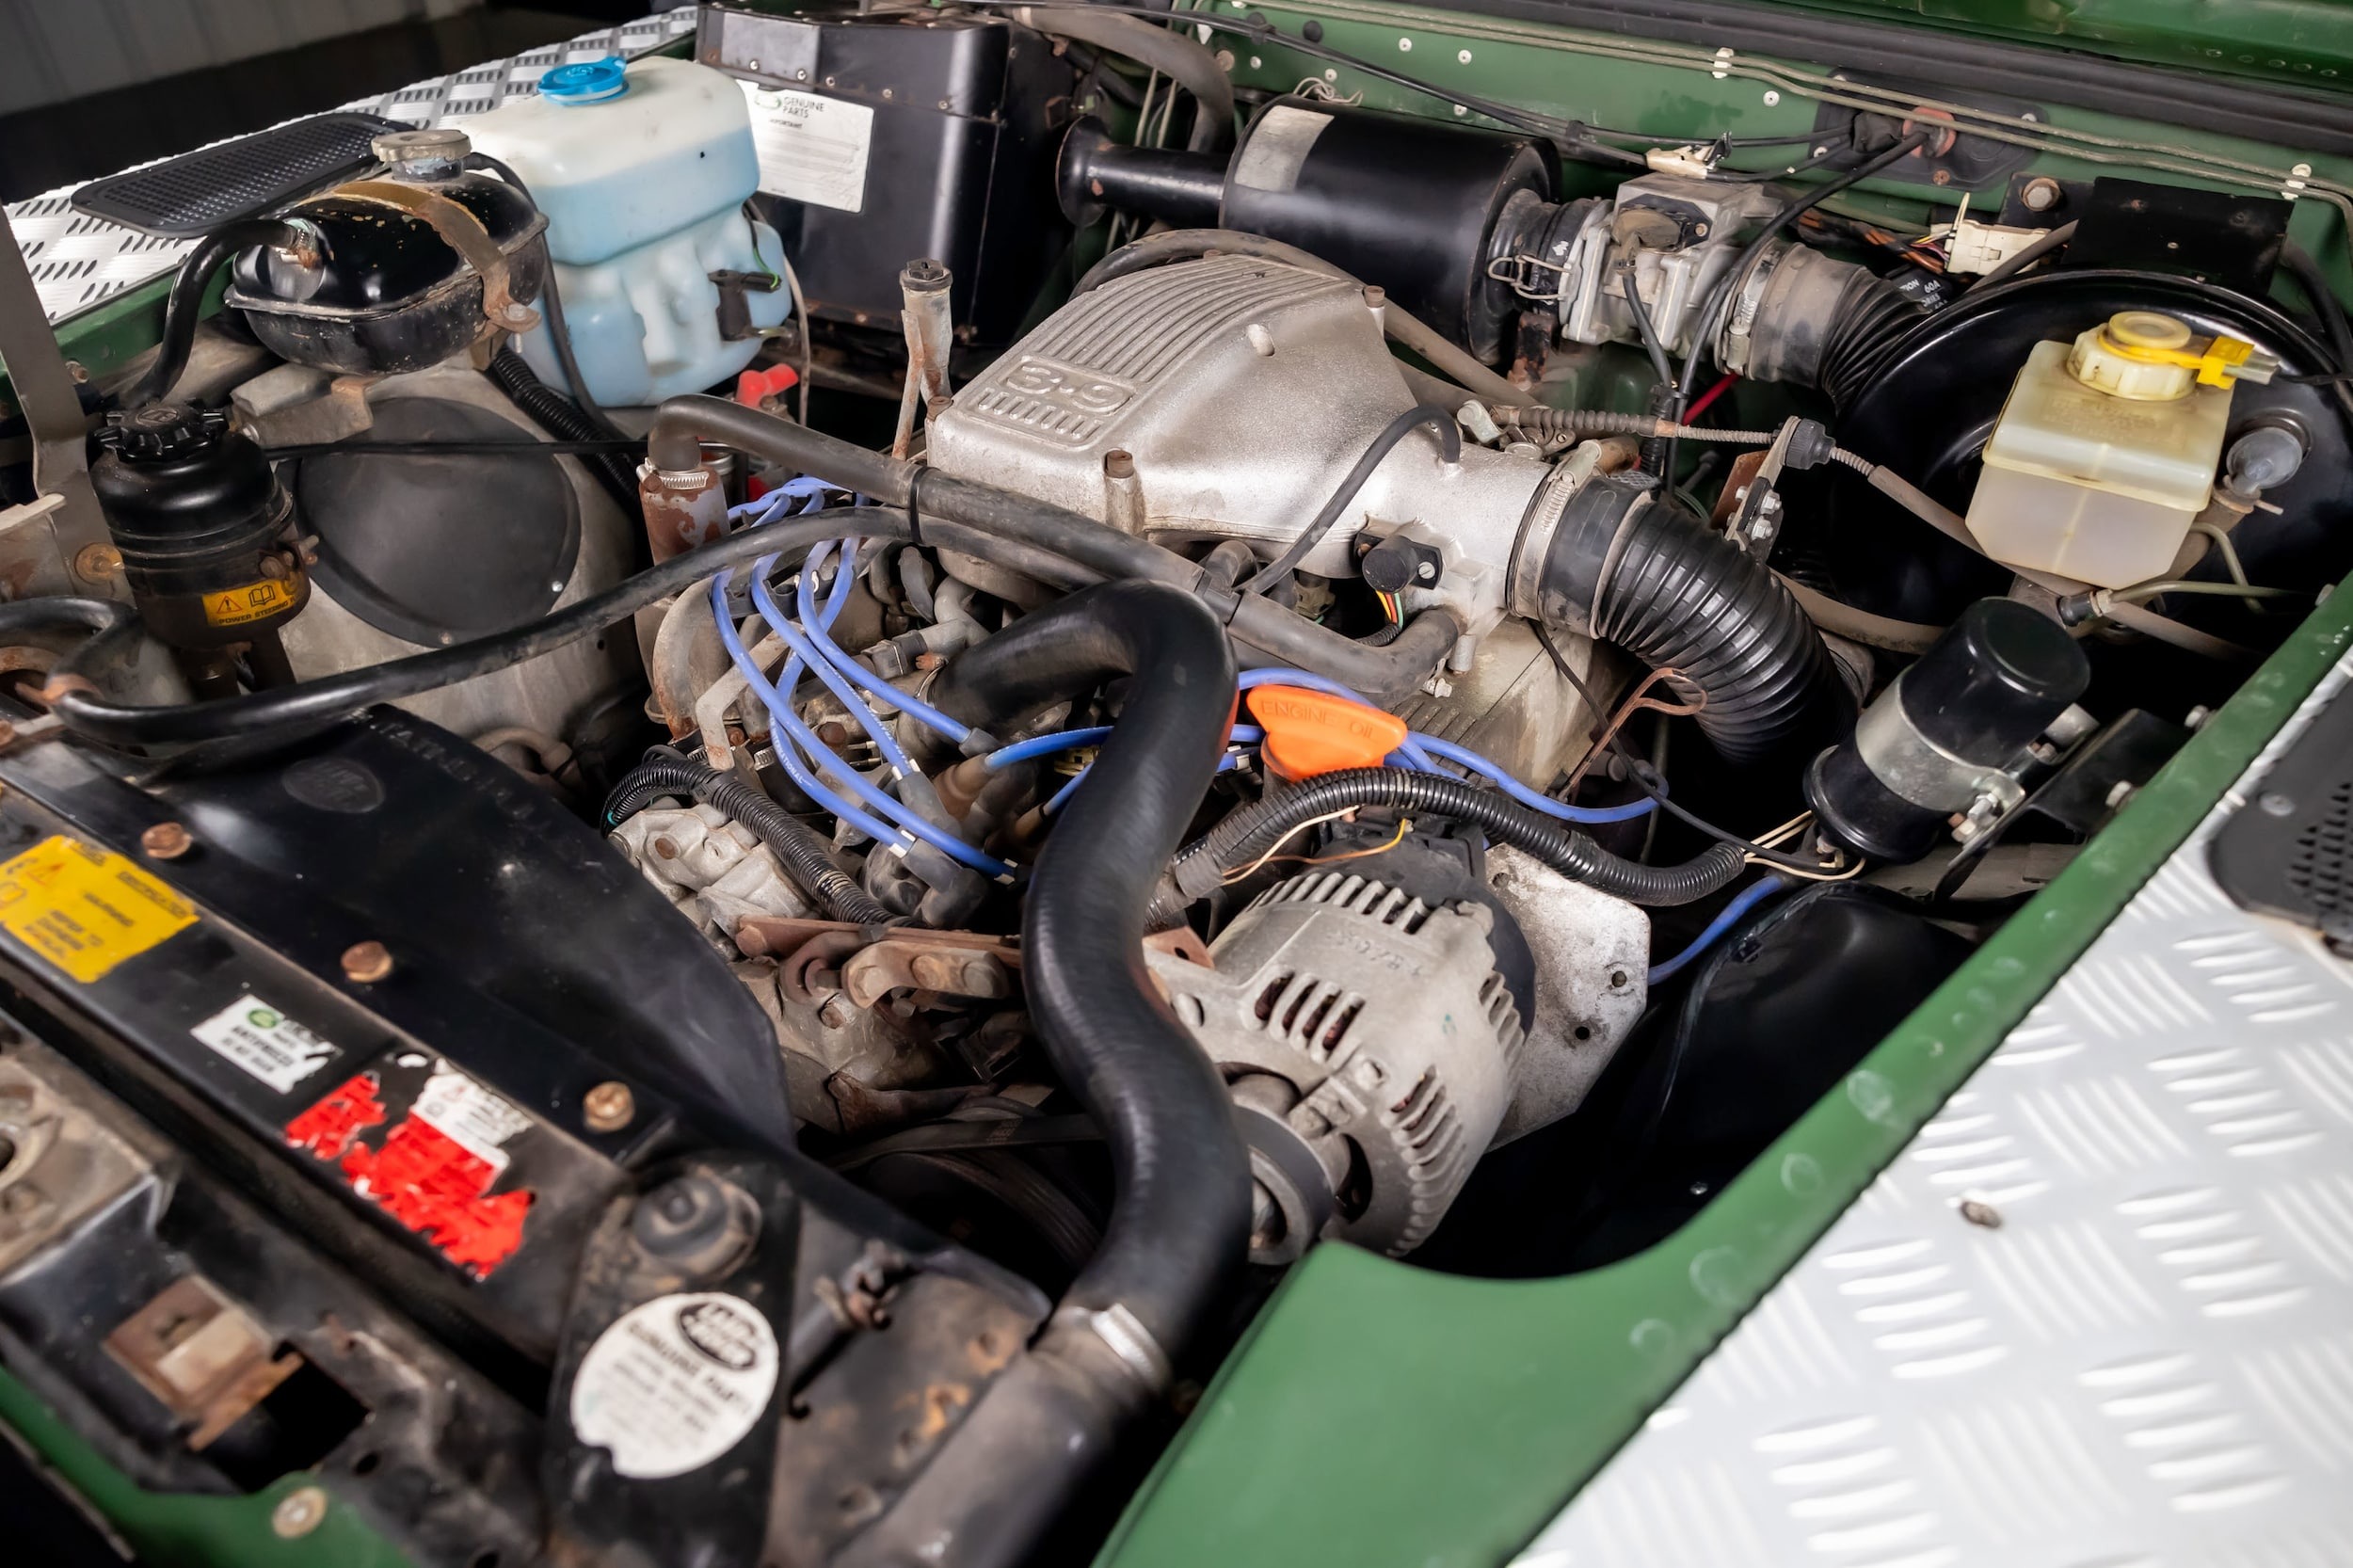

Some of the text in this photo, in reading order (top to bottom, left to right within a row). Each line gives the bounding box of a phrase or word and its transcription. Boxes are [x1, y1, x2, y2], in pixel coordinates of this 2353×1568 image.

[782, 105, 809, 119] PARTS
[784, 96, 825, 112] GENUINE
[1923, 280, 1941, 294] 60A
[217, 613, 252, 626] POWER
[254, 600, 289, 618] STEERING
[1259, 699, 1381, 743] ENGINE OIL
[771, 728, 804, 784] INTERNATIONAL
